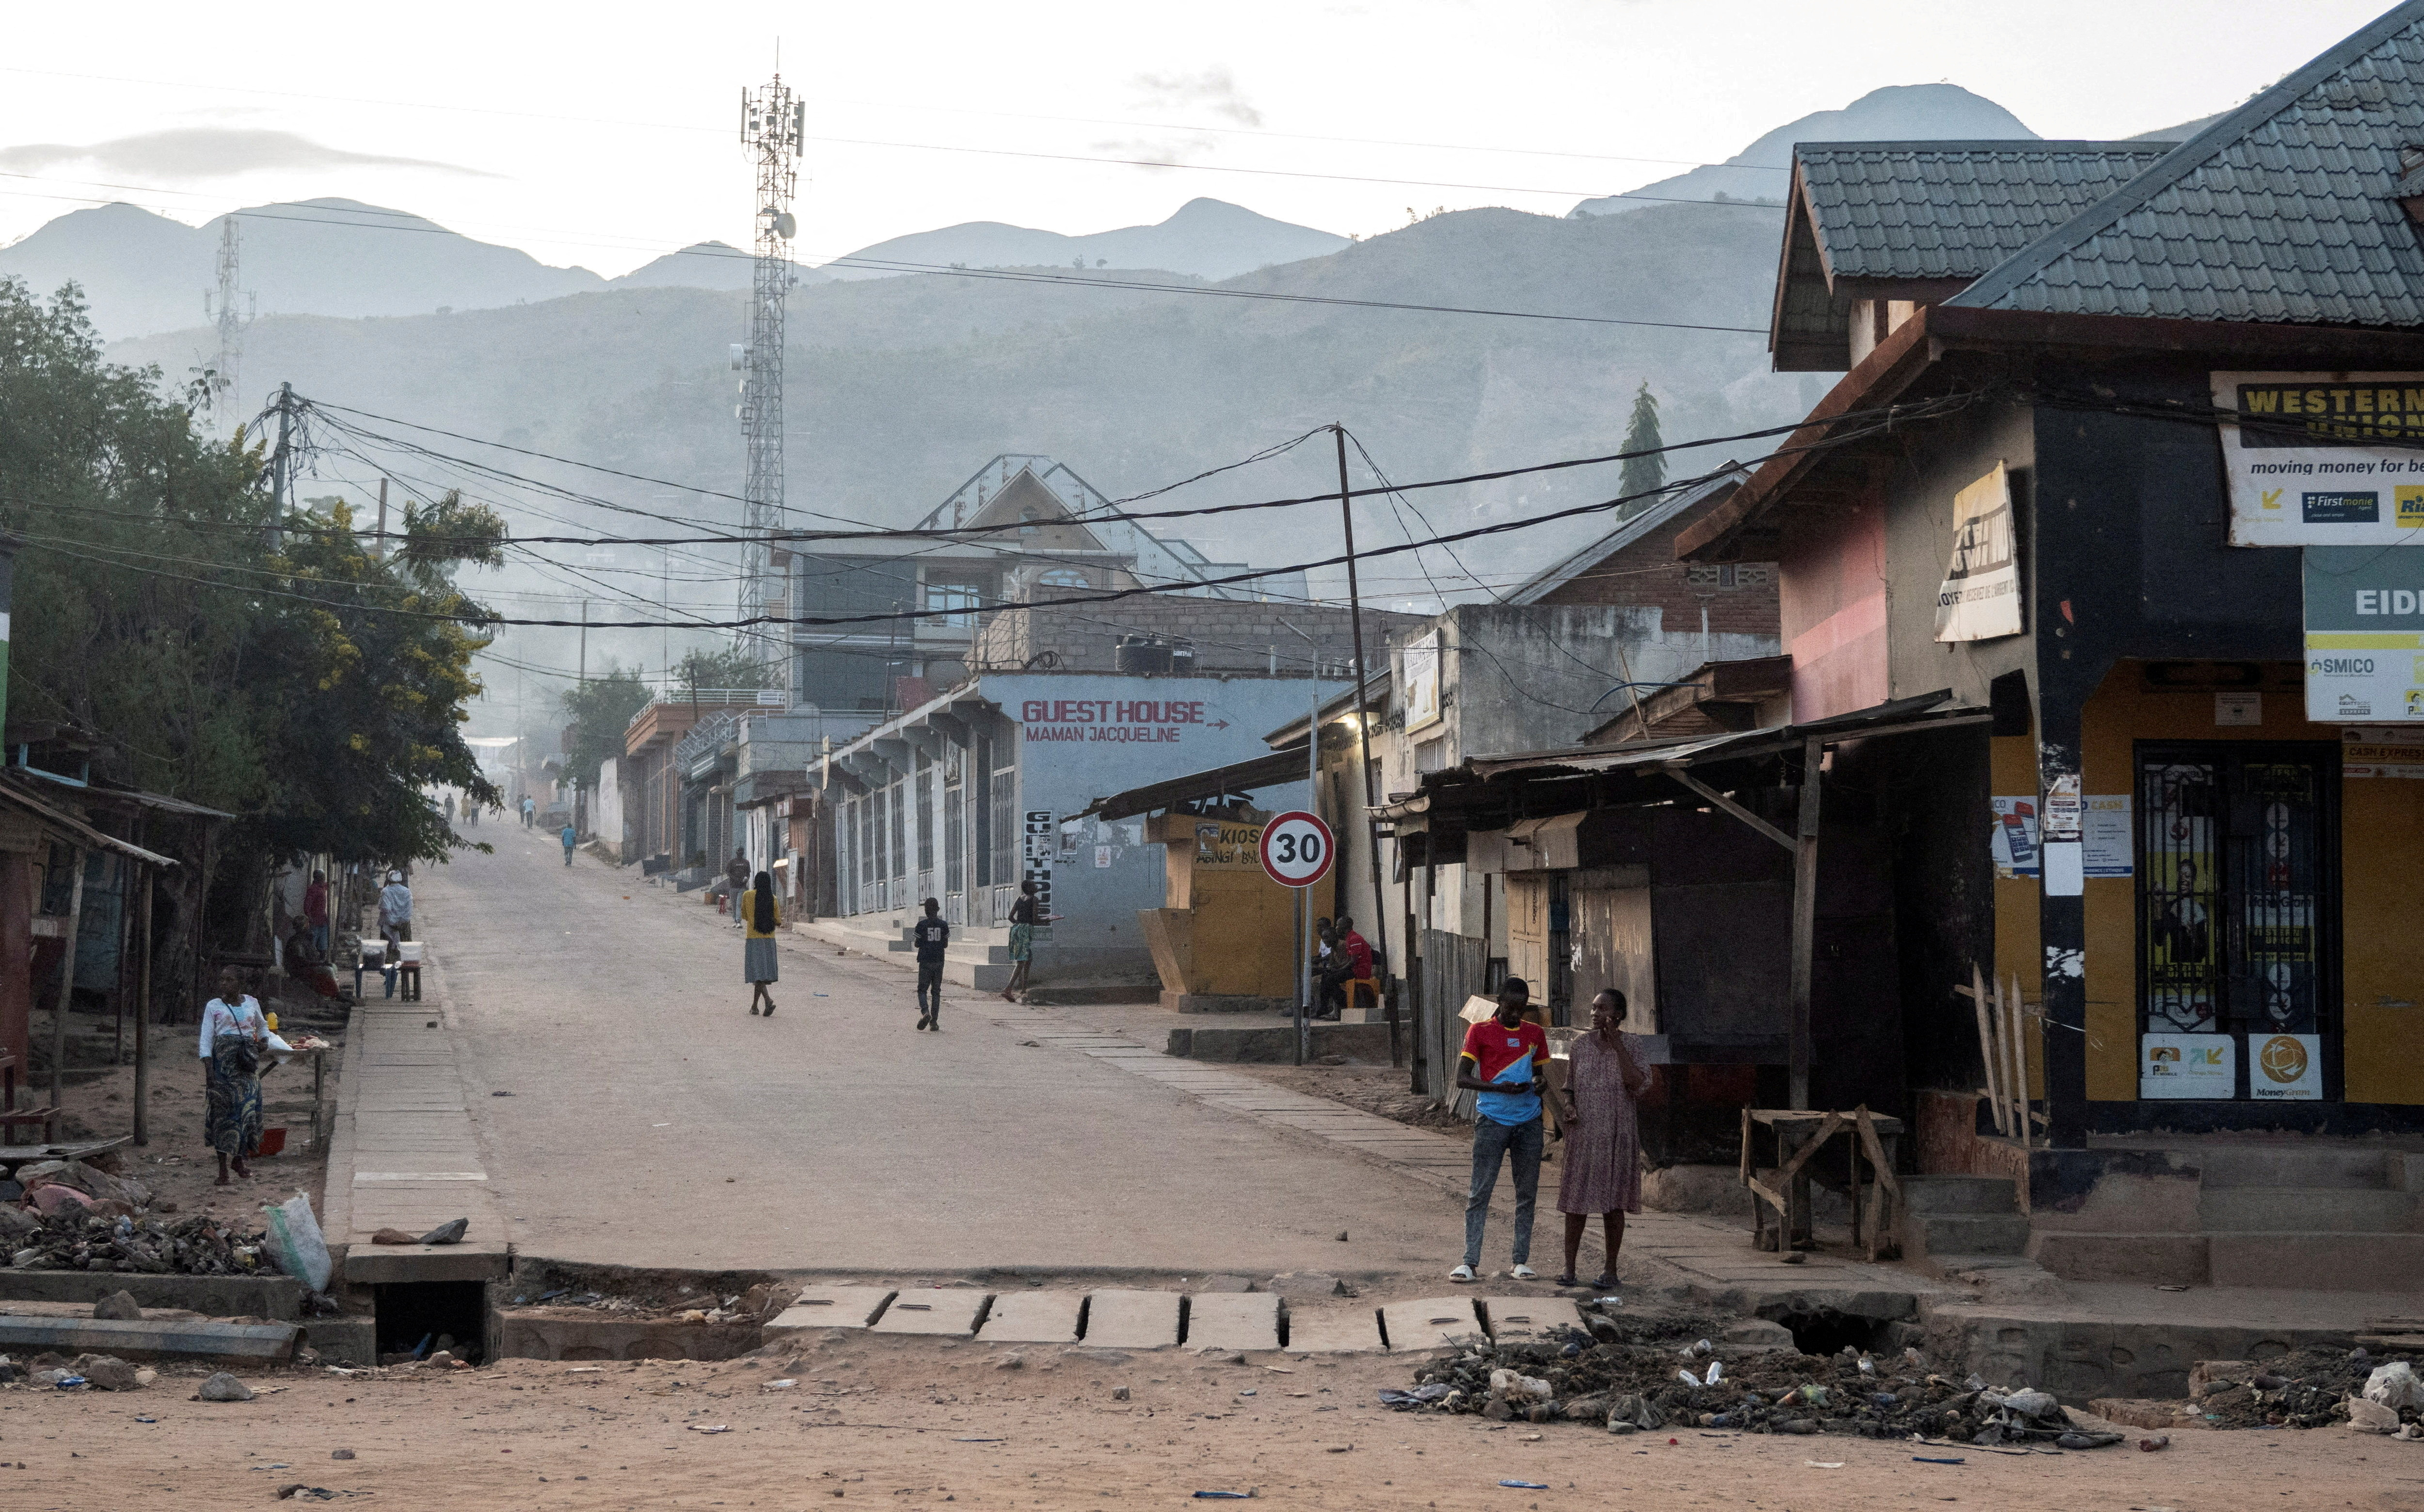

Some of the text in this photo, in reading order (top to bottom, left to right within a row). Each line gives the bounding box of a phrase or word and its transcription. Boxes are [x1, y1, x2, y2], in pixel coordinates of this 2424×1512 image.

[2246, 389, 2424, 414] WESTERN
[2251, 460, 2313, 476] moving
[2319, 462, 2375, 475] money
[2380, 459, 2404, 473] for
[1938, 591, 1962, 607] OYEZ
[2324, 658, 2374, 673] SMICO
[1022, 700, 1205, 723] GUEST HOUSE
[1026, 727, 1180, 743] MAMAN JACQUELINE
[2379, 748, 2424, 758] EXPRES
[1219, 829, 1261, 844] KIOS
[1276, 833, 1320, 863] 30
[927, 927, 941, 941] 50
